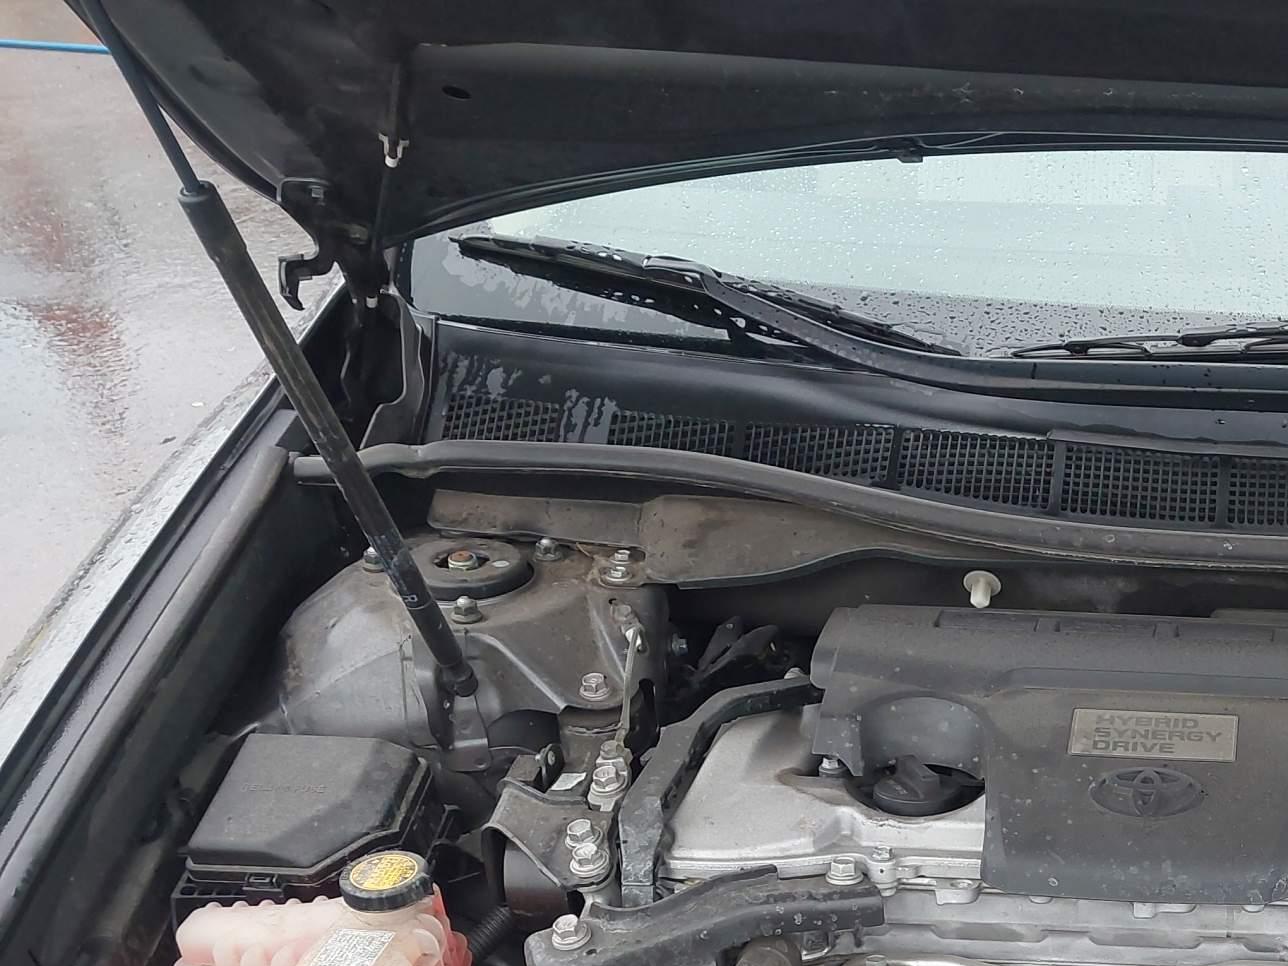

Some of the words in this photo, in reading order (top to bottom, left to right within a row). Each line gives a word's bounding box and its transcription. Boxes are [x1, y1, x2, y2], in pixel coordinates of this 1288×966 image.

[1095, 714, 1200, 730] HYBRID
[1094, 727, 1223, 742] SYNERGY
[1092, 740, 1176, 754] DRIVE
